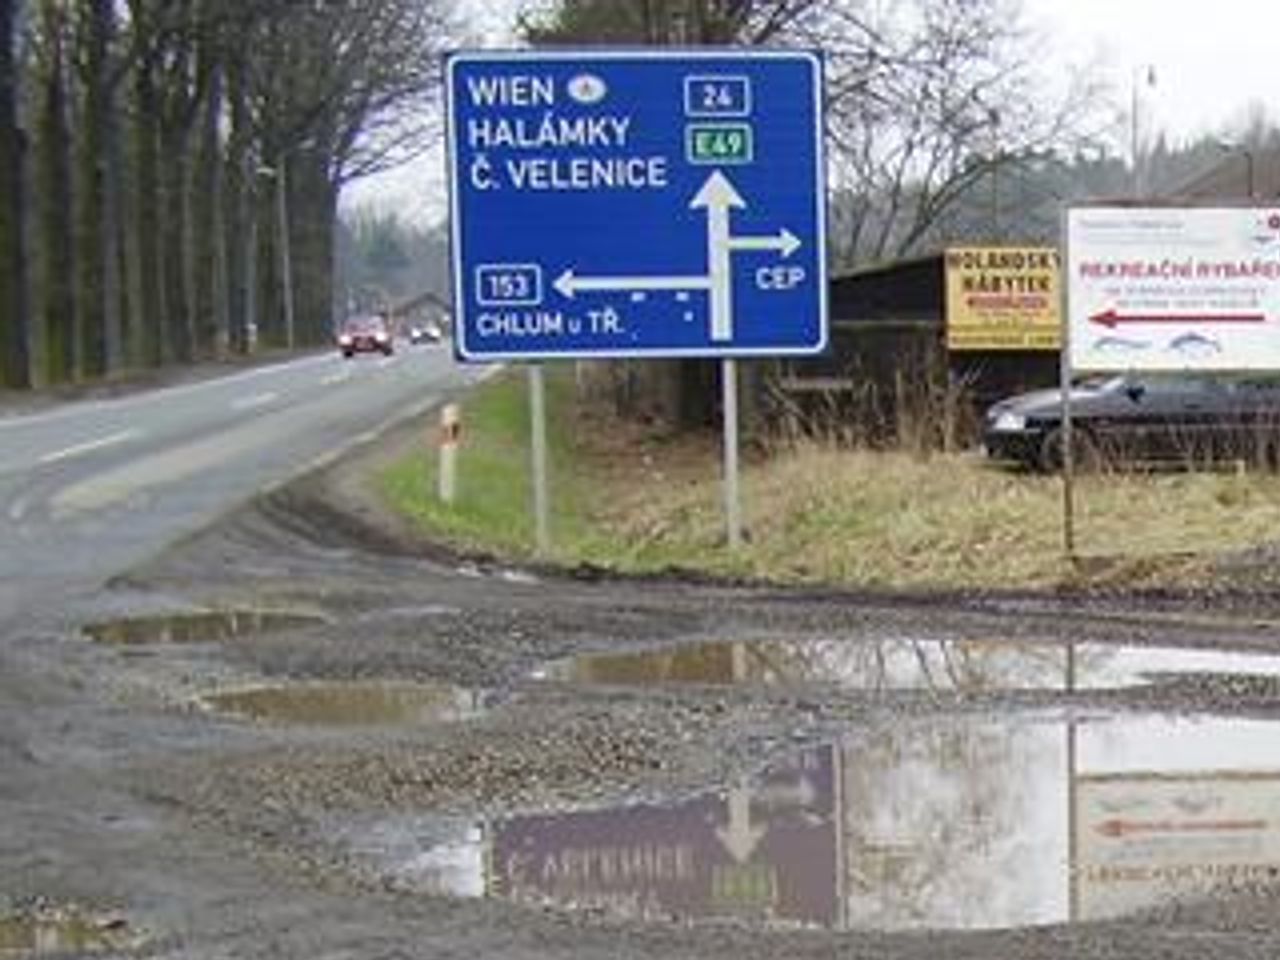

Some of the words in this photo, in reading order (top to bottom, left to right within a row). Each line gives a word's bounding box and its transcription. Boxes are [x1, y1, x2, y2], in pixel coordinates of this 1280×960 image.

[468, 76, 555, 106] WIEN
[703, 84, 731, 106] 24
[468, 111, 631, 147] HALÁMKY
[696, 132, 742, 154] E49
[471, 153, 500, 190] Č.
[507, 156, 669, 189] VELENICE
[488, 274, 528, 297] 153
[755, 267, 806, 290] CEP
[476, 311, 563, 337] CHLUM
